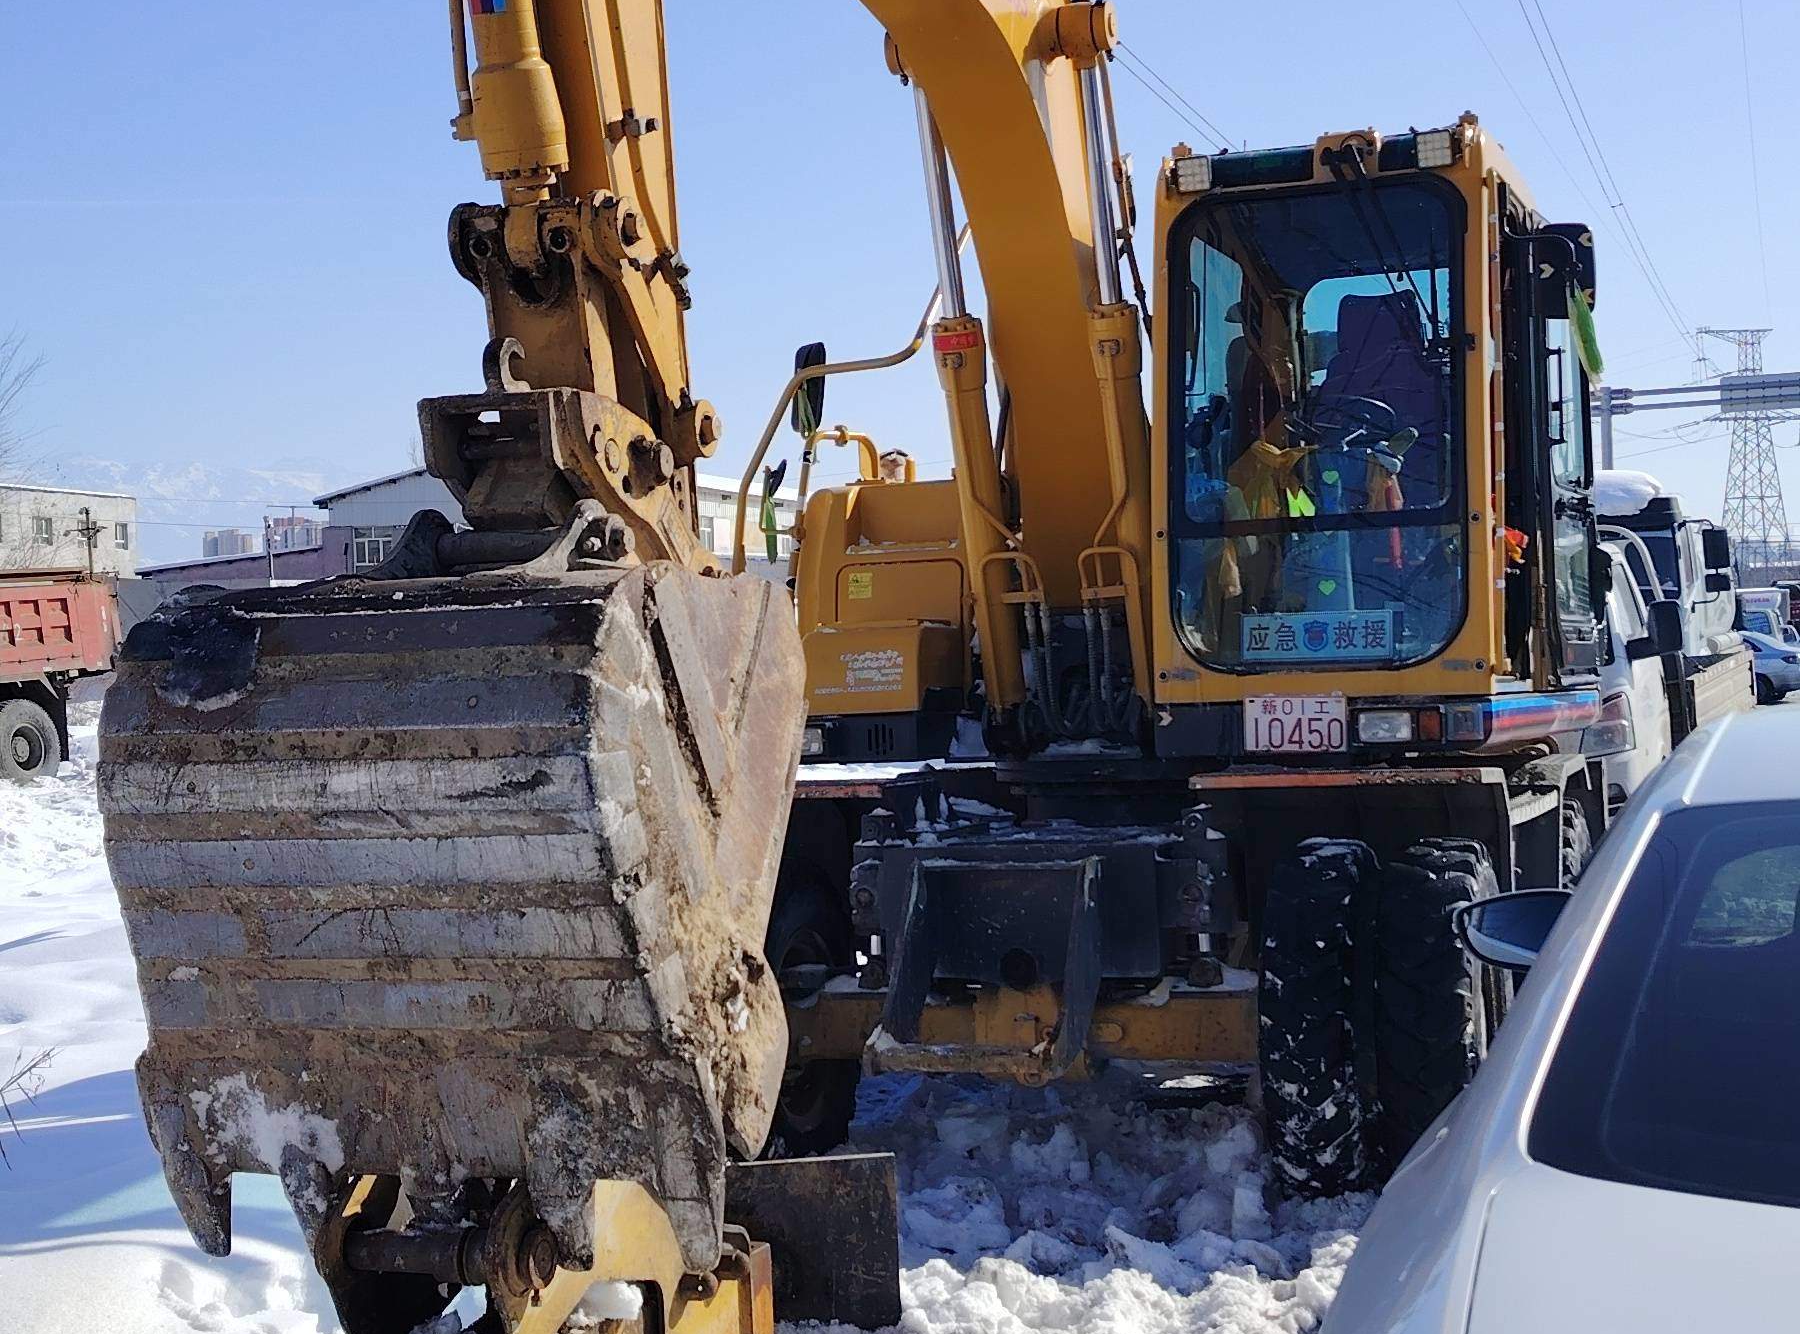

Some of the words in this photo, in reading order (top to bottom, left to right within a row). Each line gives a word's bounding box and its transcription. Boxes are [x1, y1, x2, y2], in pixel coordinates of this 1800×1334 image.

[1246, 619, 1386, 653] 应急救援
[1253, 717, 1344, 750] 10450
